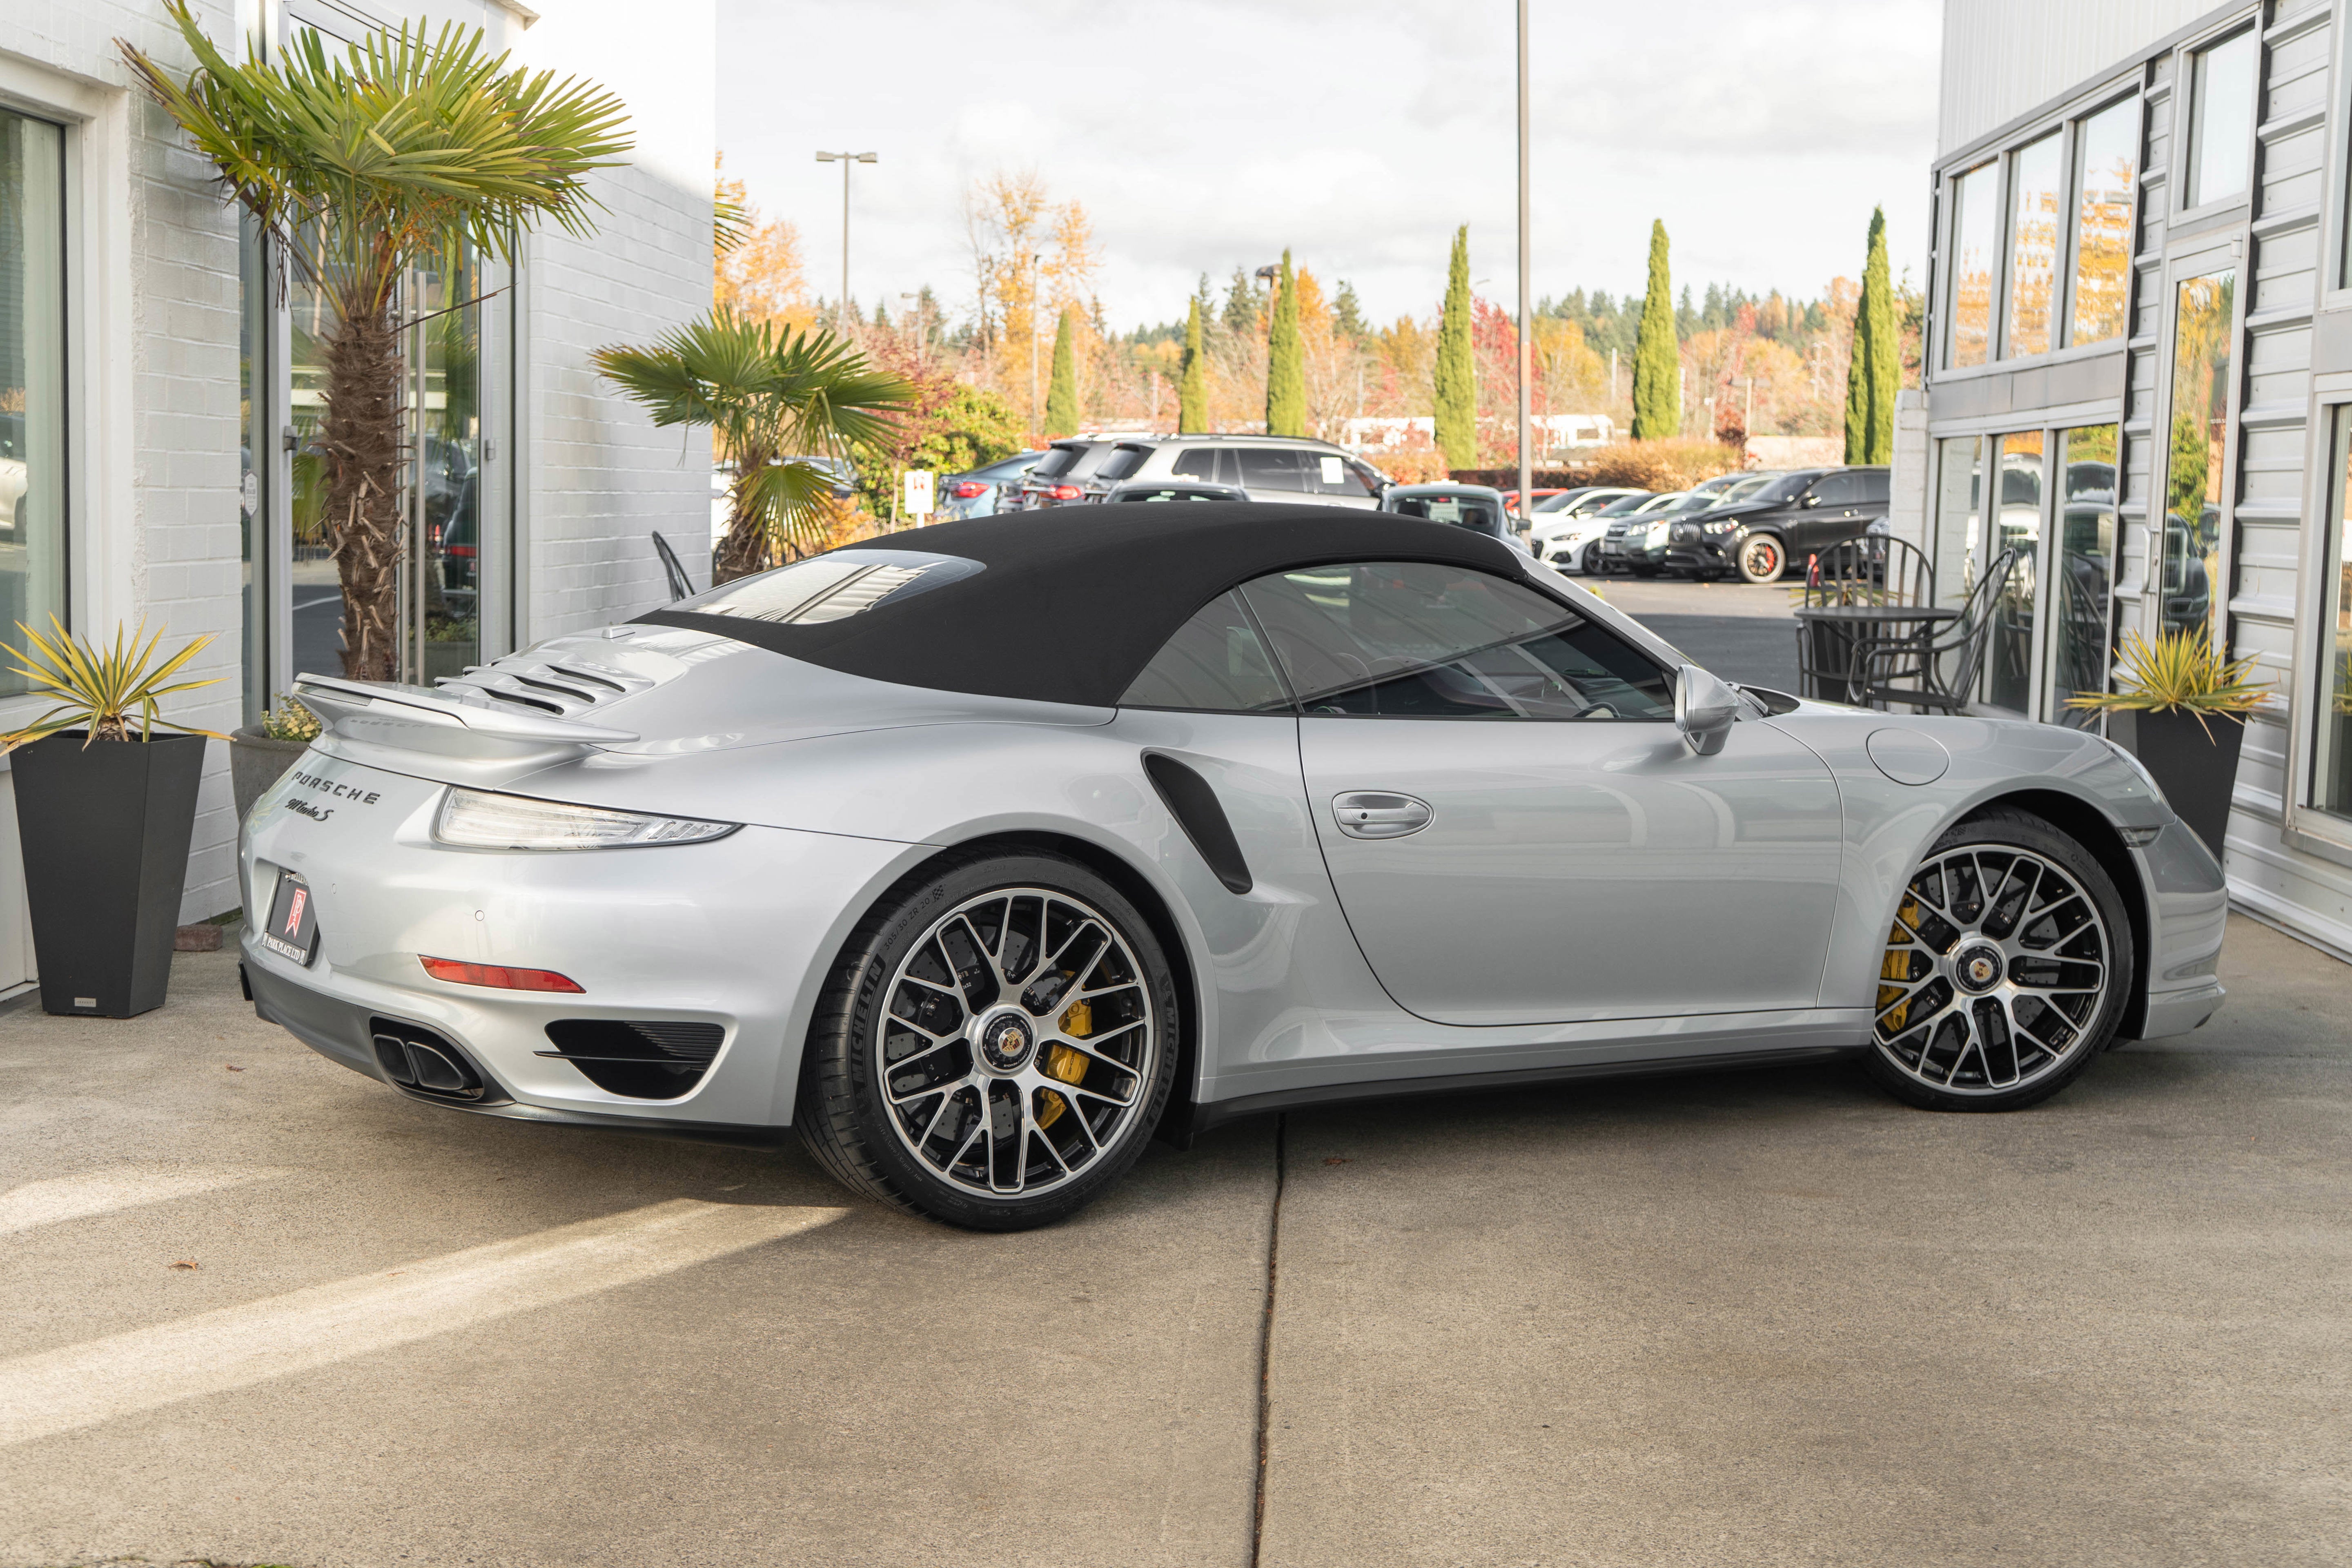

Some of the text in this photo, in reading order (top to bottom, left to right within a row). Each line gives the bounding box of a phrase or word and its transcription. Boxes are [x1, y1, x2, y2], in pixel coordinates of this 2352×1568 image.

[292, 771, 380, 804] PORSCHE
[267, 937, 300, 960] PARK PLACE LTD
[884, 919, 907, 950] 305/30
[909, 907, 919, 920] ZR
[920, 898, 930, 909] 20
[851, 961, 882, 1082] MICHELIN
[1150, 1007, 1175, 1120] MICHELIN
